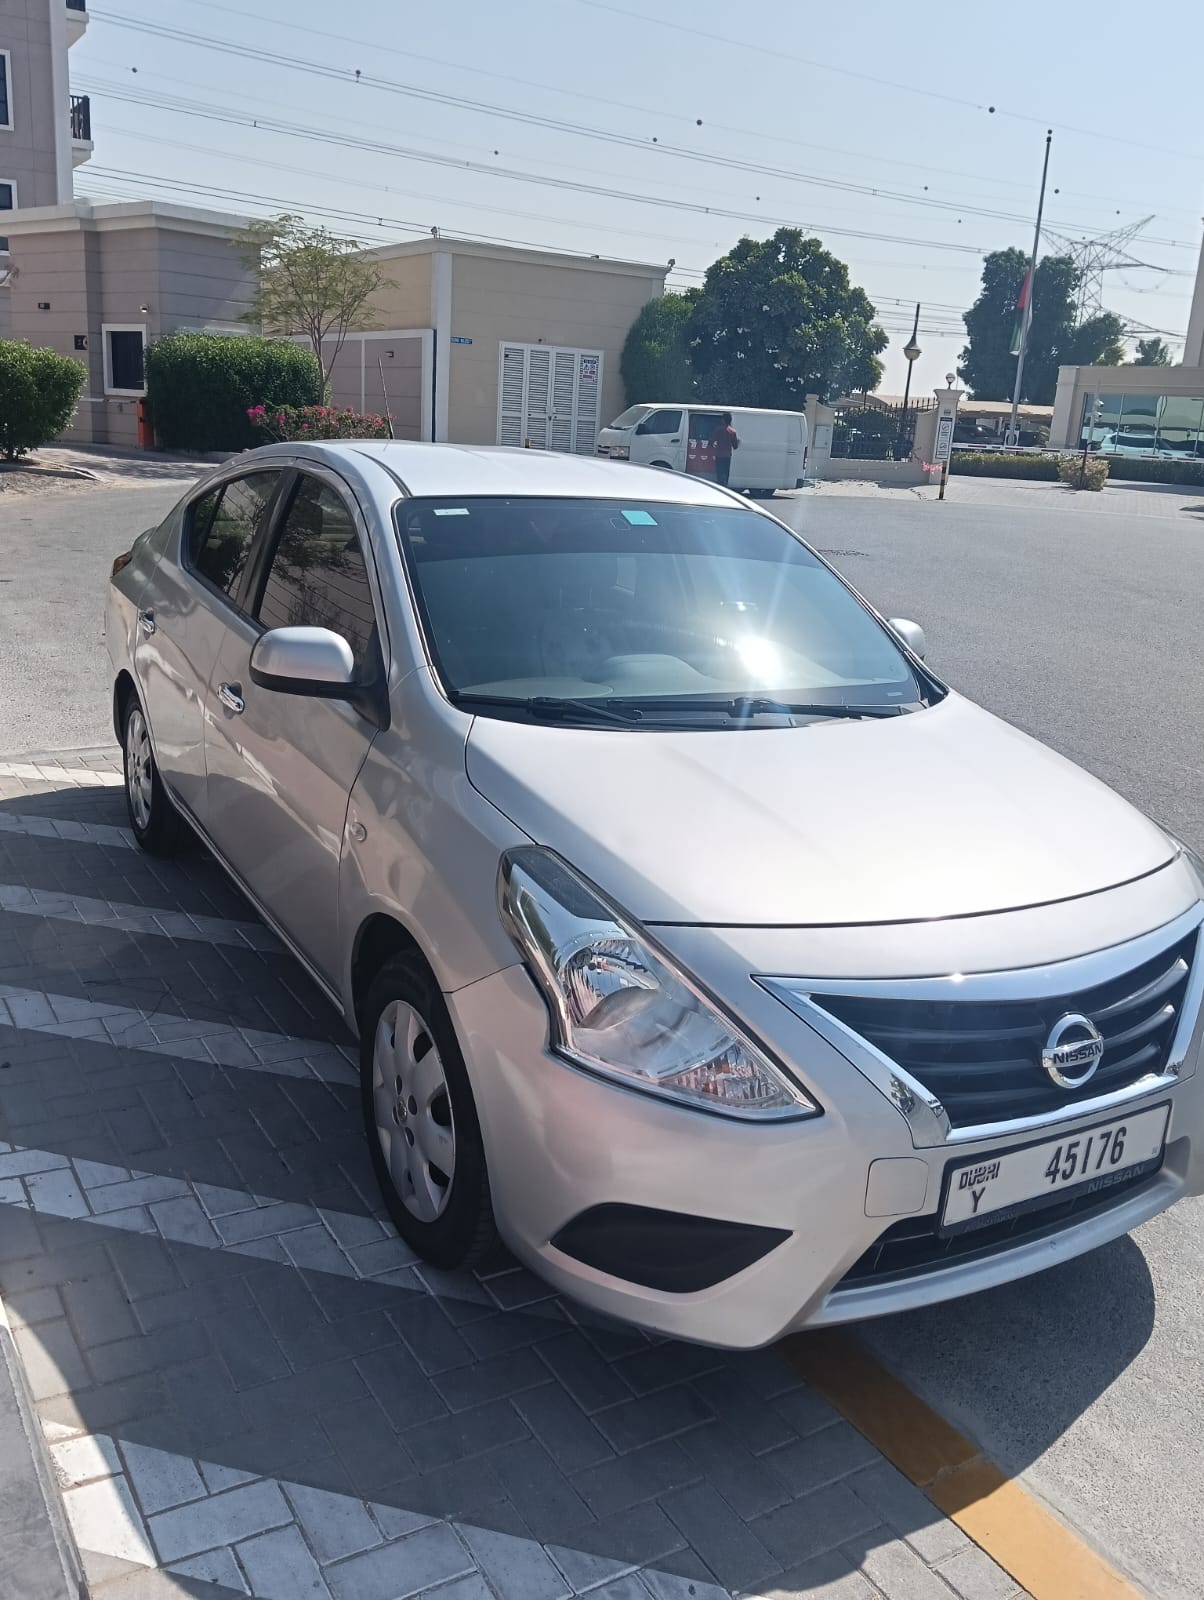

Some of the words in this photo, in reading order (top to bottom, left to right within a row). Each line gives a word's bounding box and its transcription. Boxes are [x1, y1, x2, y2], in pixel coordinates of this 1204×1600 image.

[1053, 1042, 1102, 1065] NISSAN
[1045, 1126, 1127, 1184] 45176
[959, 1161, 1000, 1190] DUBAI
[1087, 1166, 1145, 1193] NISSAN
[972, 1187, 986, 1213] Y
